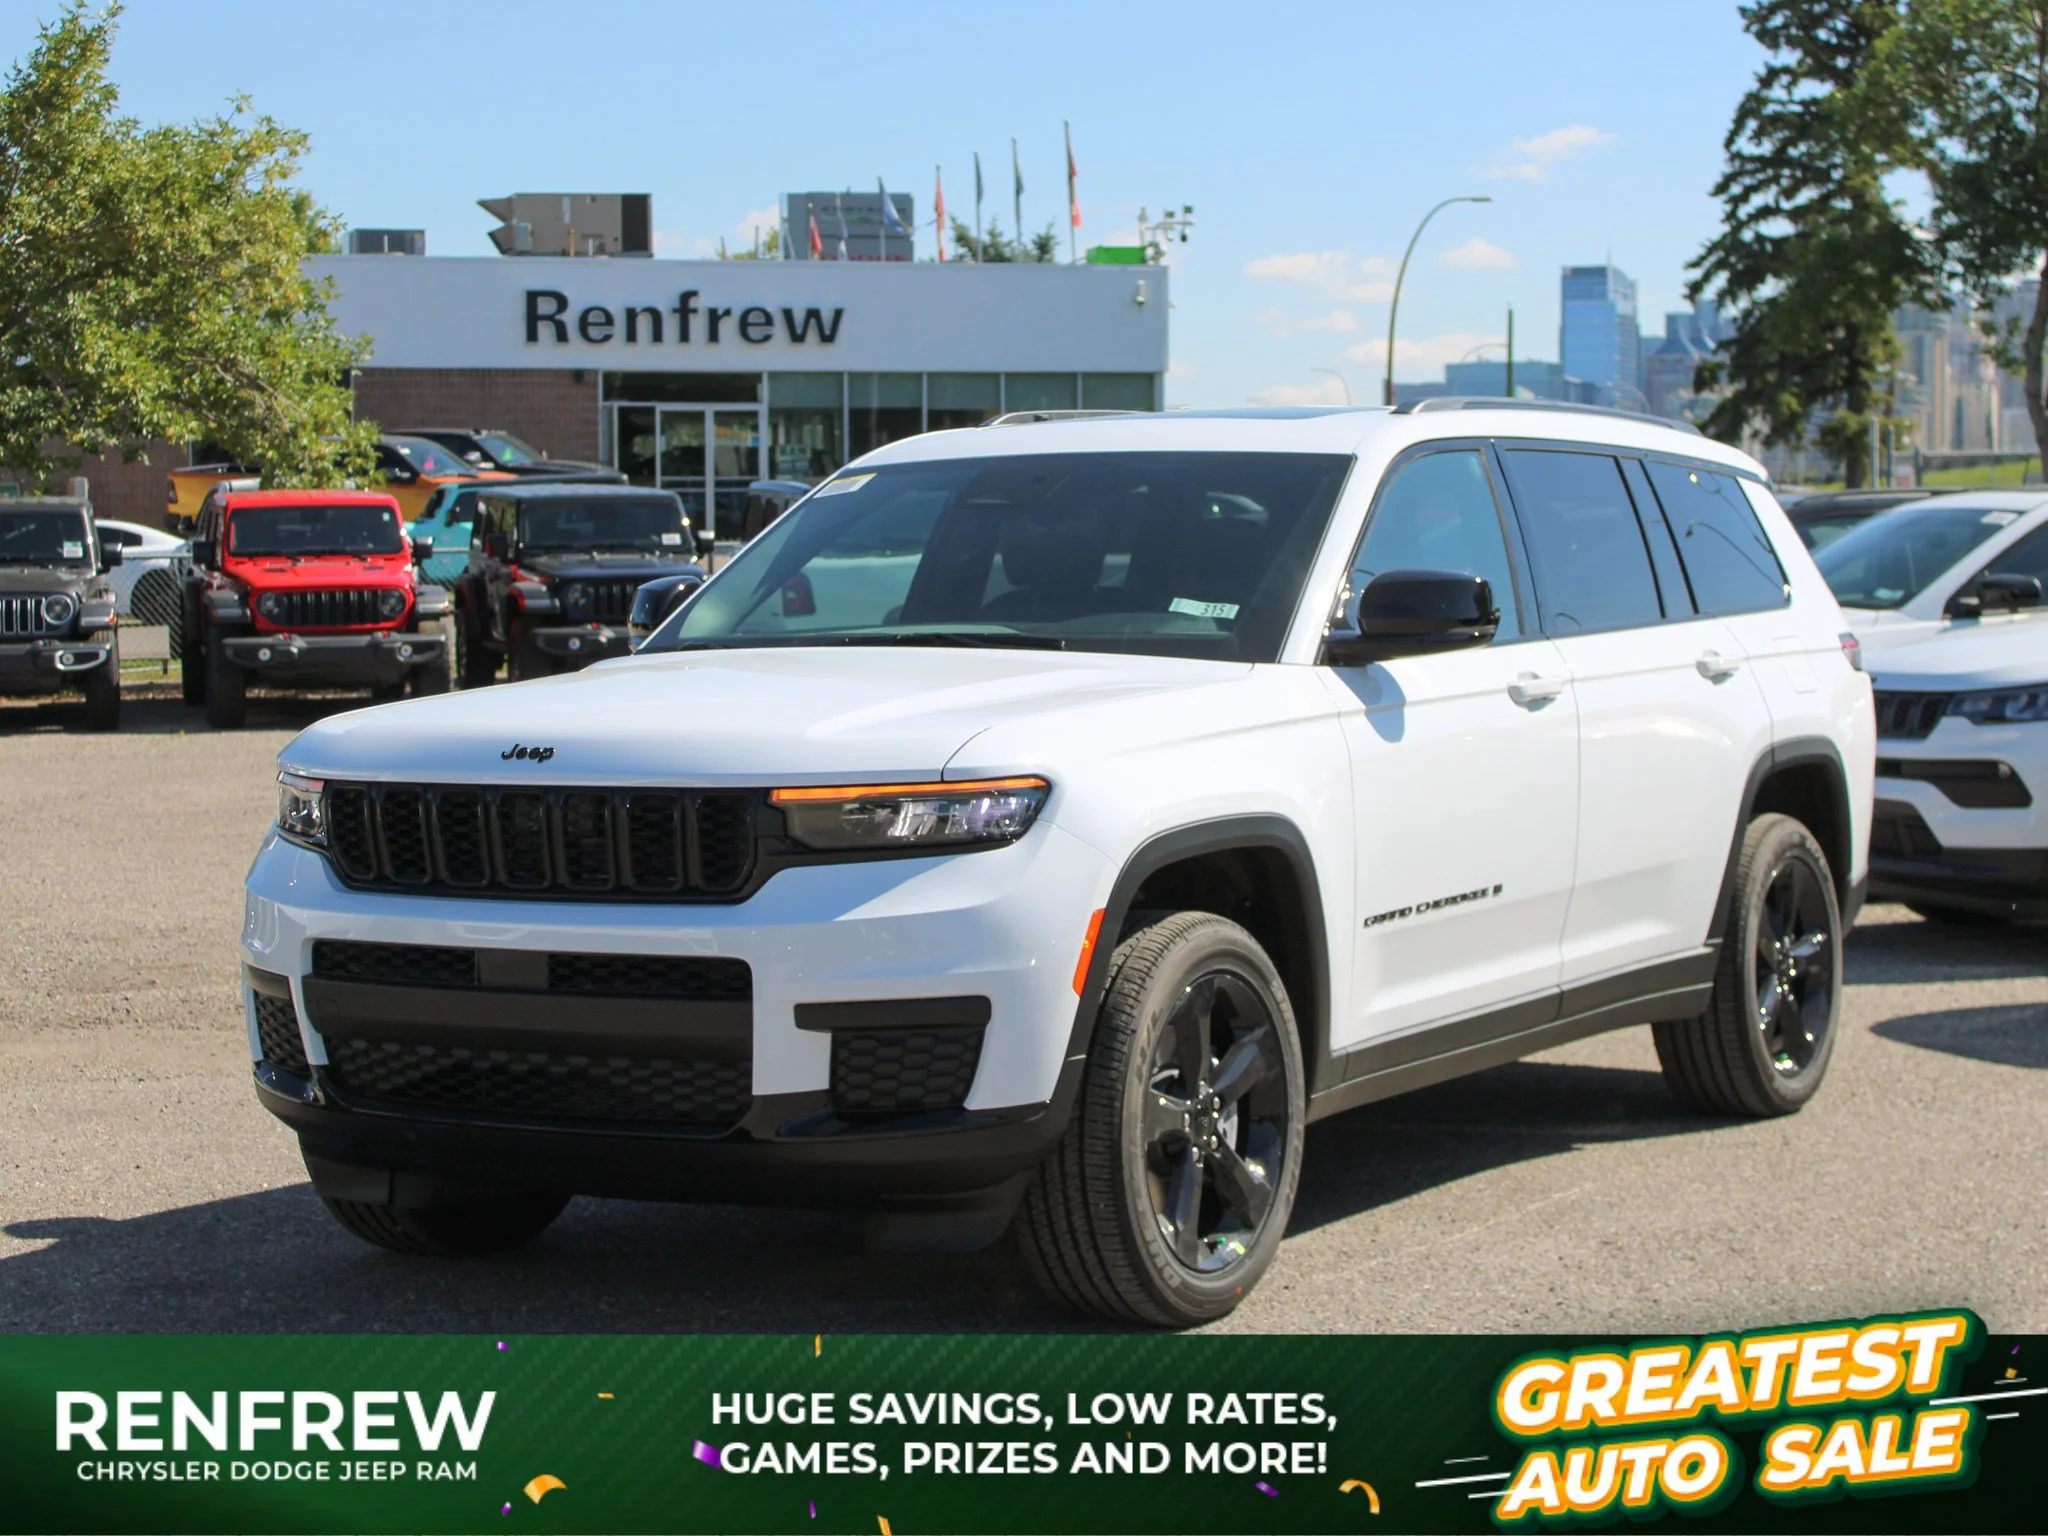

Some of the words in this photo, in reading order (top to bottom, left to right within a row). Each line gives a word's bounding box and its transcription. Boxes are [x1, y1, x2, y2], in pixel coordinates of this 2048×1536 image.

[525, 289, 844, 344] Renfrew
[501, 743, 556, 763] Jeep
[1363, 906, 1413, 928] GRAND
[1415, 887, 1490, 914] CHEROKEE
